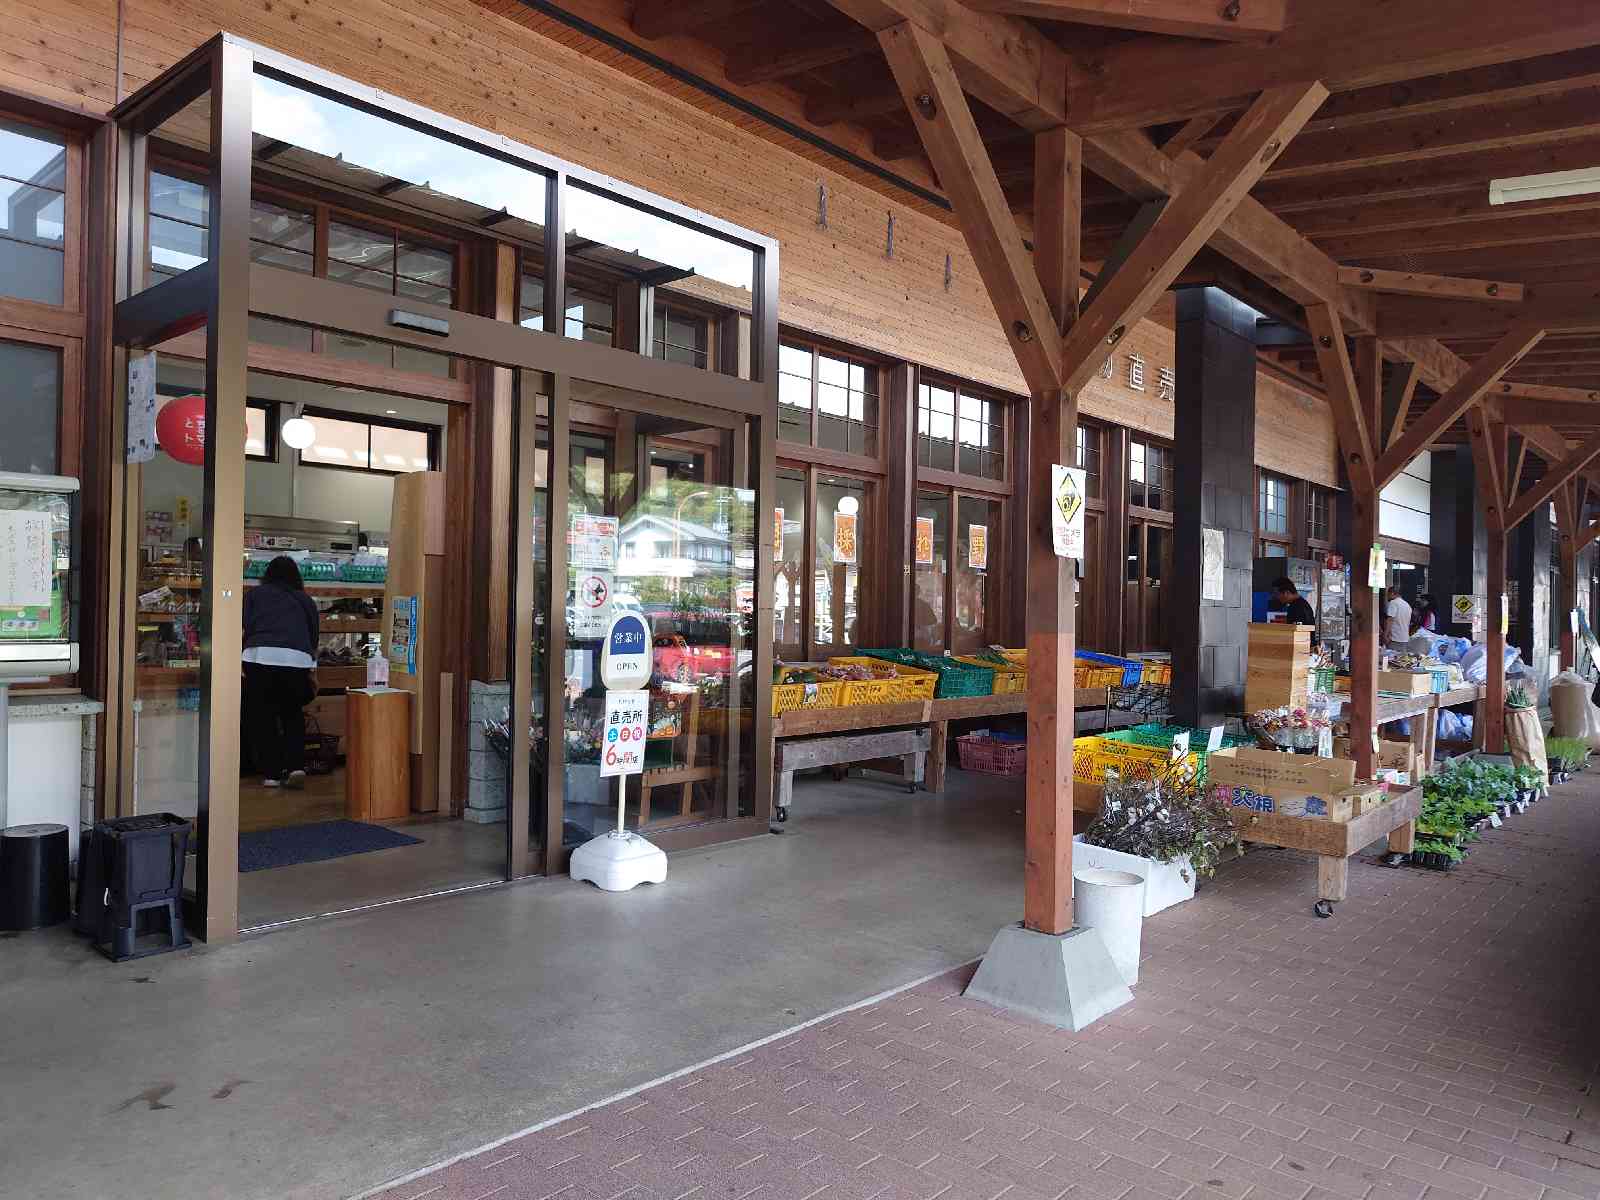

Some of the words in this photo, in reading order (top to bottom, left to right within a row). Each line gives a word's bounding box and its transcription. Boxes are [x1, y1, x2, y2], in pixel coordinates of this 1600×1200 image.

[614, 631, 643, 645] 営業中
[616, 662, 639, 671] OPEN
[609, 710, 643, 725] 直売所
